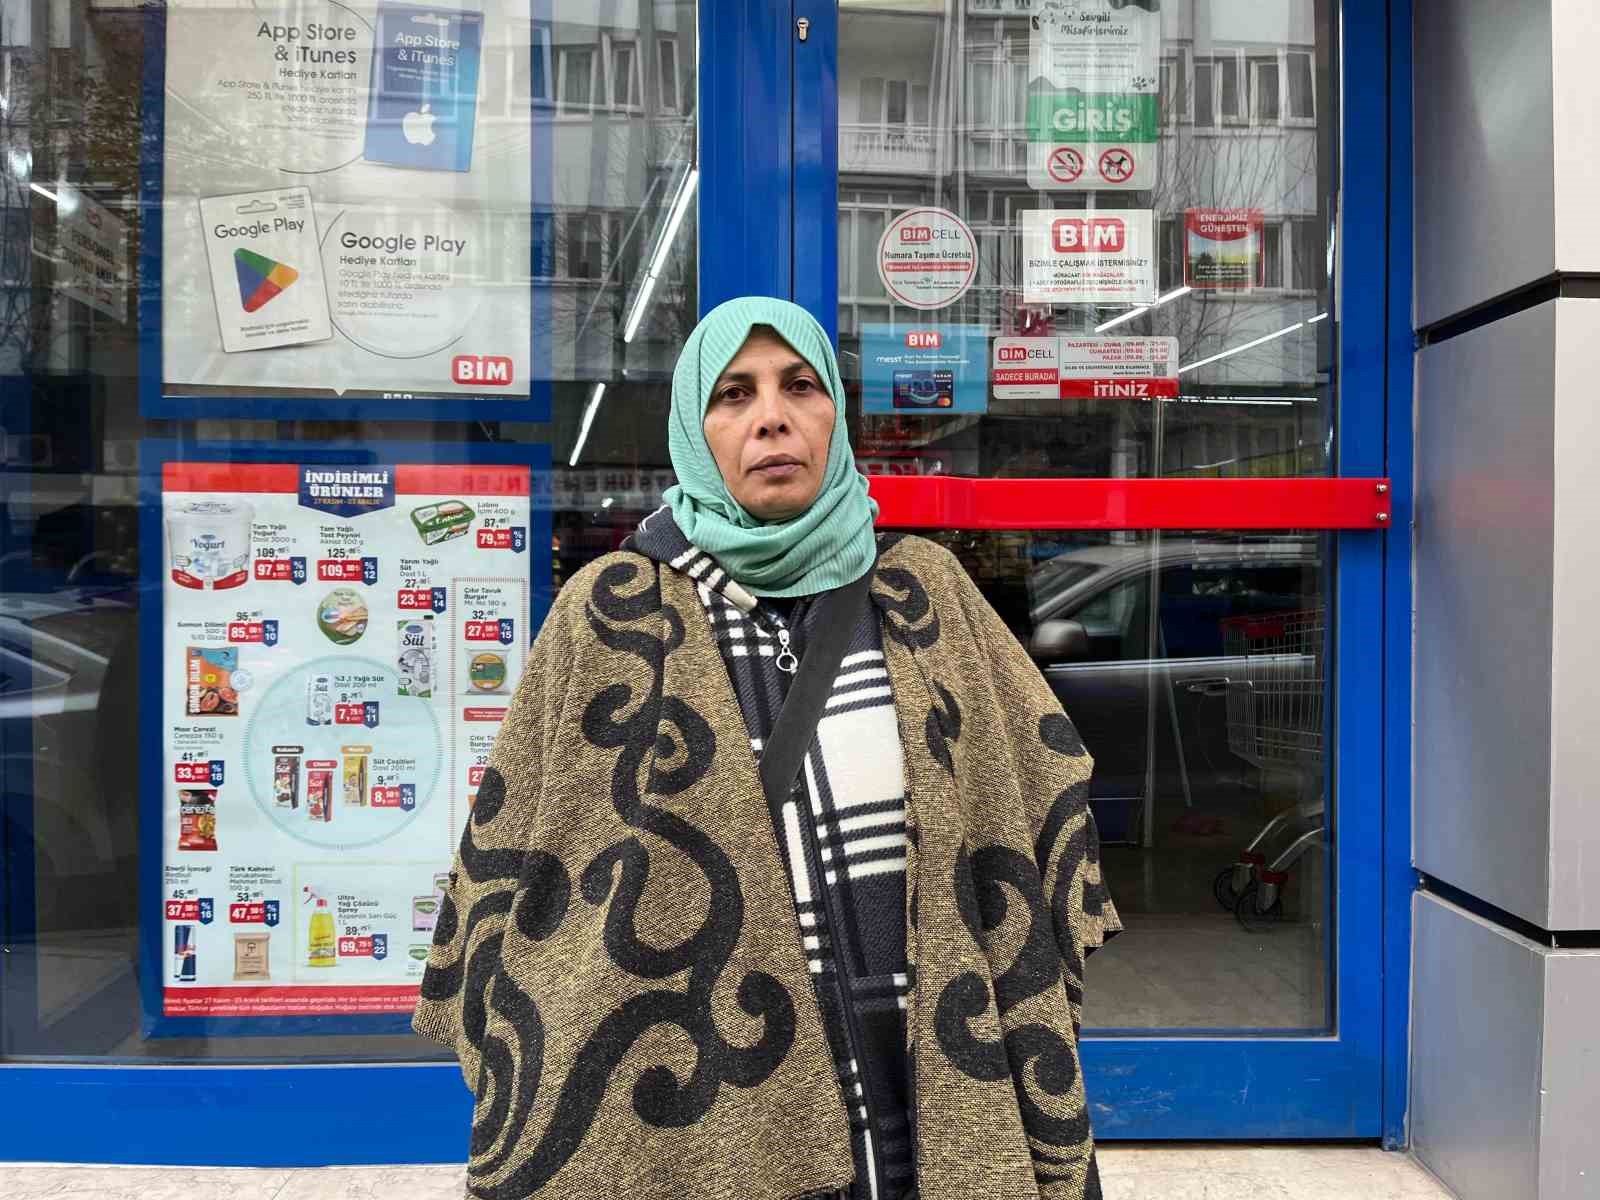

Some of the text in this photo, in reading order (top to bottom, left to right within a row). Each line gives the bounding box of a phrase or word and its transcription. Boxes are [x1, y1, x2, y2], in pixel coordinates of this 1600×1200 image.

[257, 21, 357, 42] App Store
[395, 32, 461, 50] App Store
[274, 46, 357, 64] & iTunes
[397, 49, 456, 66] & iTunes
[280, 68, 319, 80] Hediye
[214, 217, 305, 239] Google Play
[340, 232, 466, 256] Google Play
[885, 251, 912, 259] Numara
[914, 251, 940, 260] Taşıma
[339, 255, 376, 267] Hediye
[996, 373, 1024, 382] SADECE
[1093, 380, 1149, 397] İTİNİZ
[304, 469, 389, 484] İNDİRİMLİ
[309, 484, 384, 498] ÜRÜNLER
[515, 539, 522, 547] 8
[293, 569, 305, 578] 10
[364, 571, 376, 580] 12
[433, 599, 445, 608] 14
[265, 632, 276, 641] 10
[402, 633, 425, 646] Süt
[501, 631, 512, 639] 15
[366, 714, 376, 722] 11
[211, 772, 222, 782] 18
[402, 796, 414, 805] 10
[200, 910, 212, 919] 16
[266, 912, 278, 921] 11
[374, 945, 386, 955] 22
